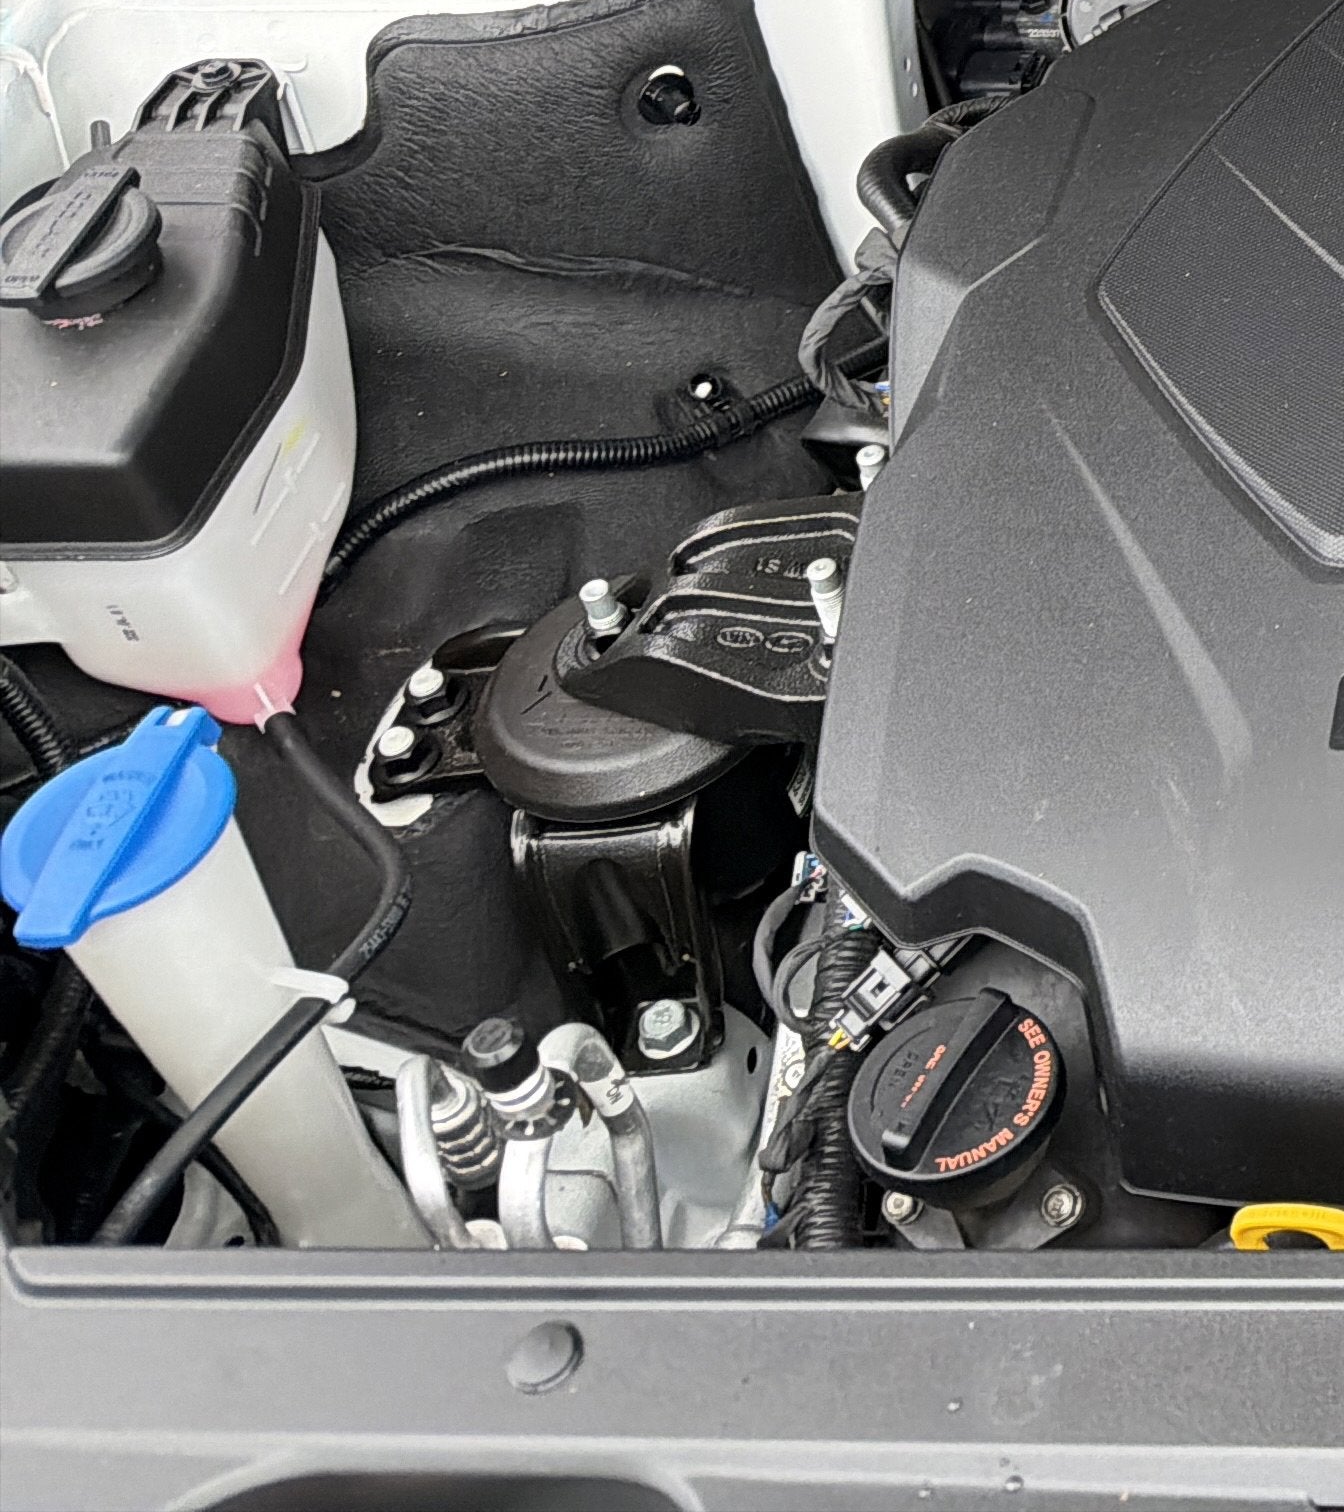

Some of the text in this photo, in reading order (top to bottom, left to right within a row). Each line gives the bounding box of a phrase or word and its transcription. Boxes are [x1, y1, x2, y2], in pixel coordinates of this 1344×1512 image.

[934, 1018, 1051, 1172] SEE OWNER'S MANUAL
